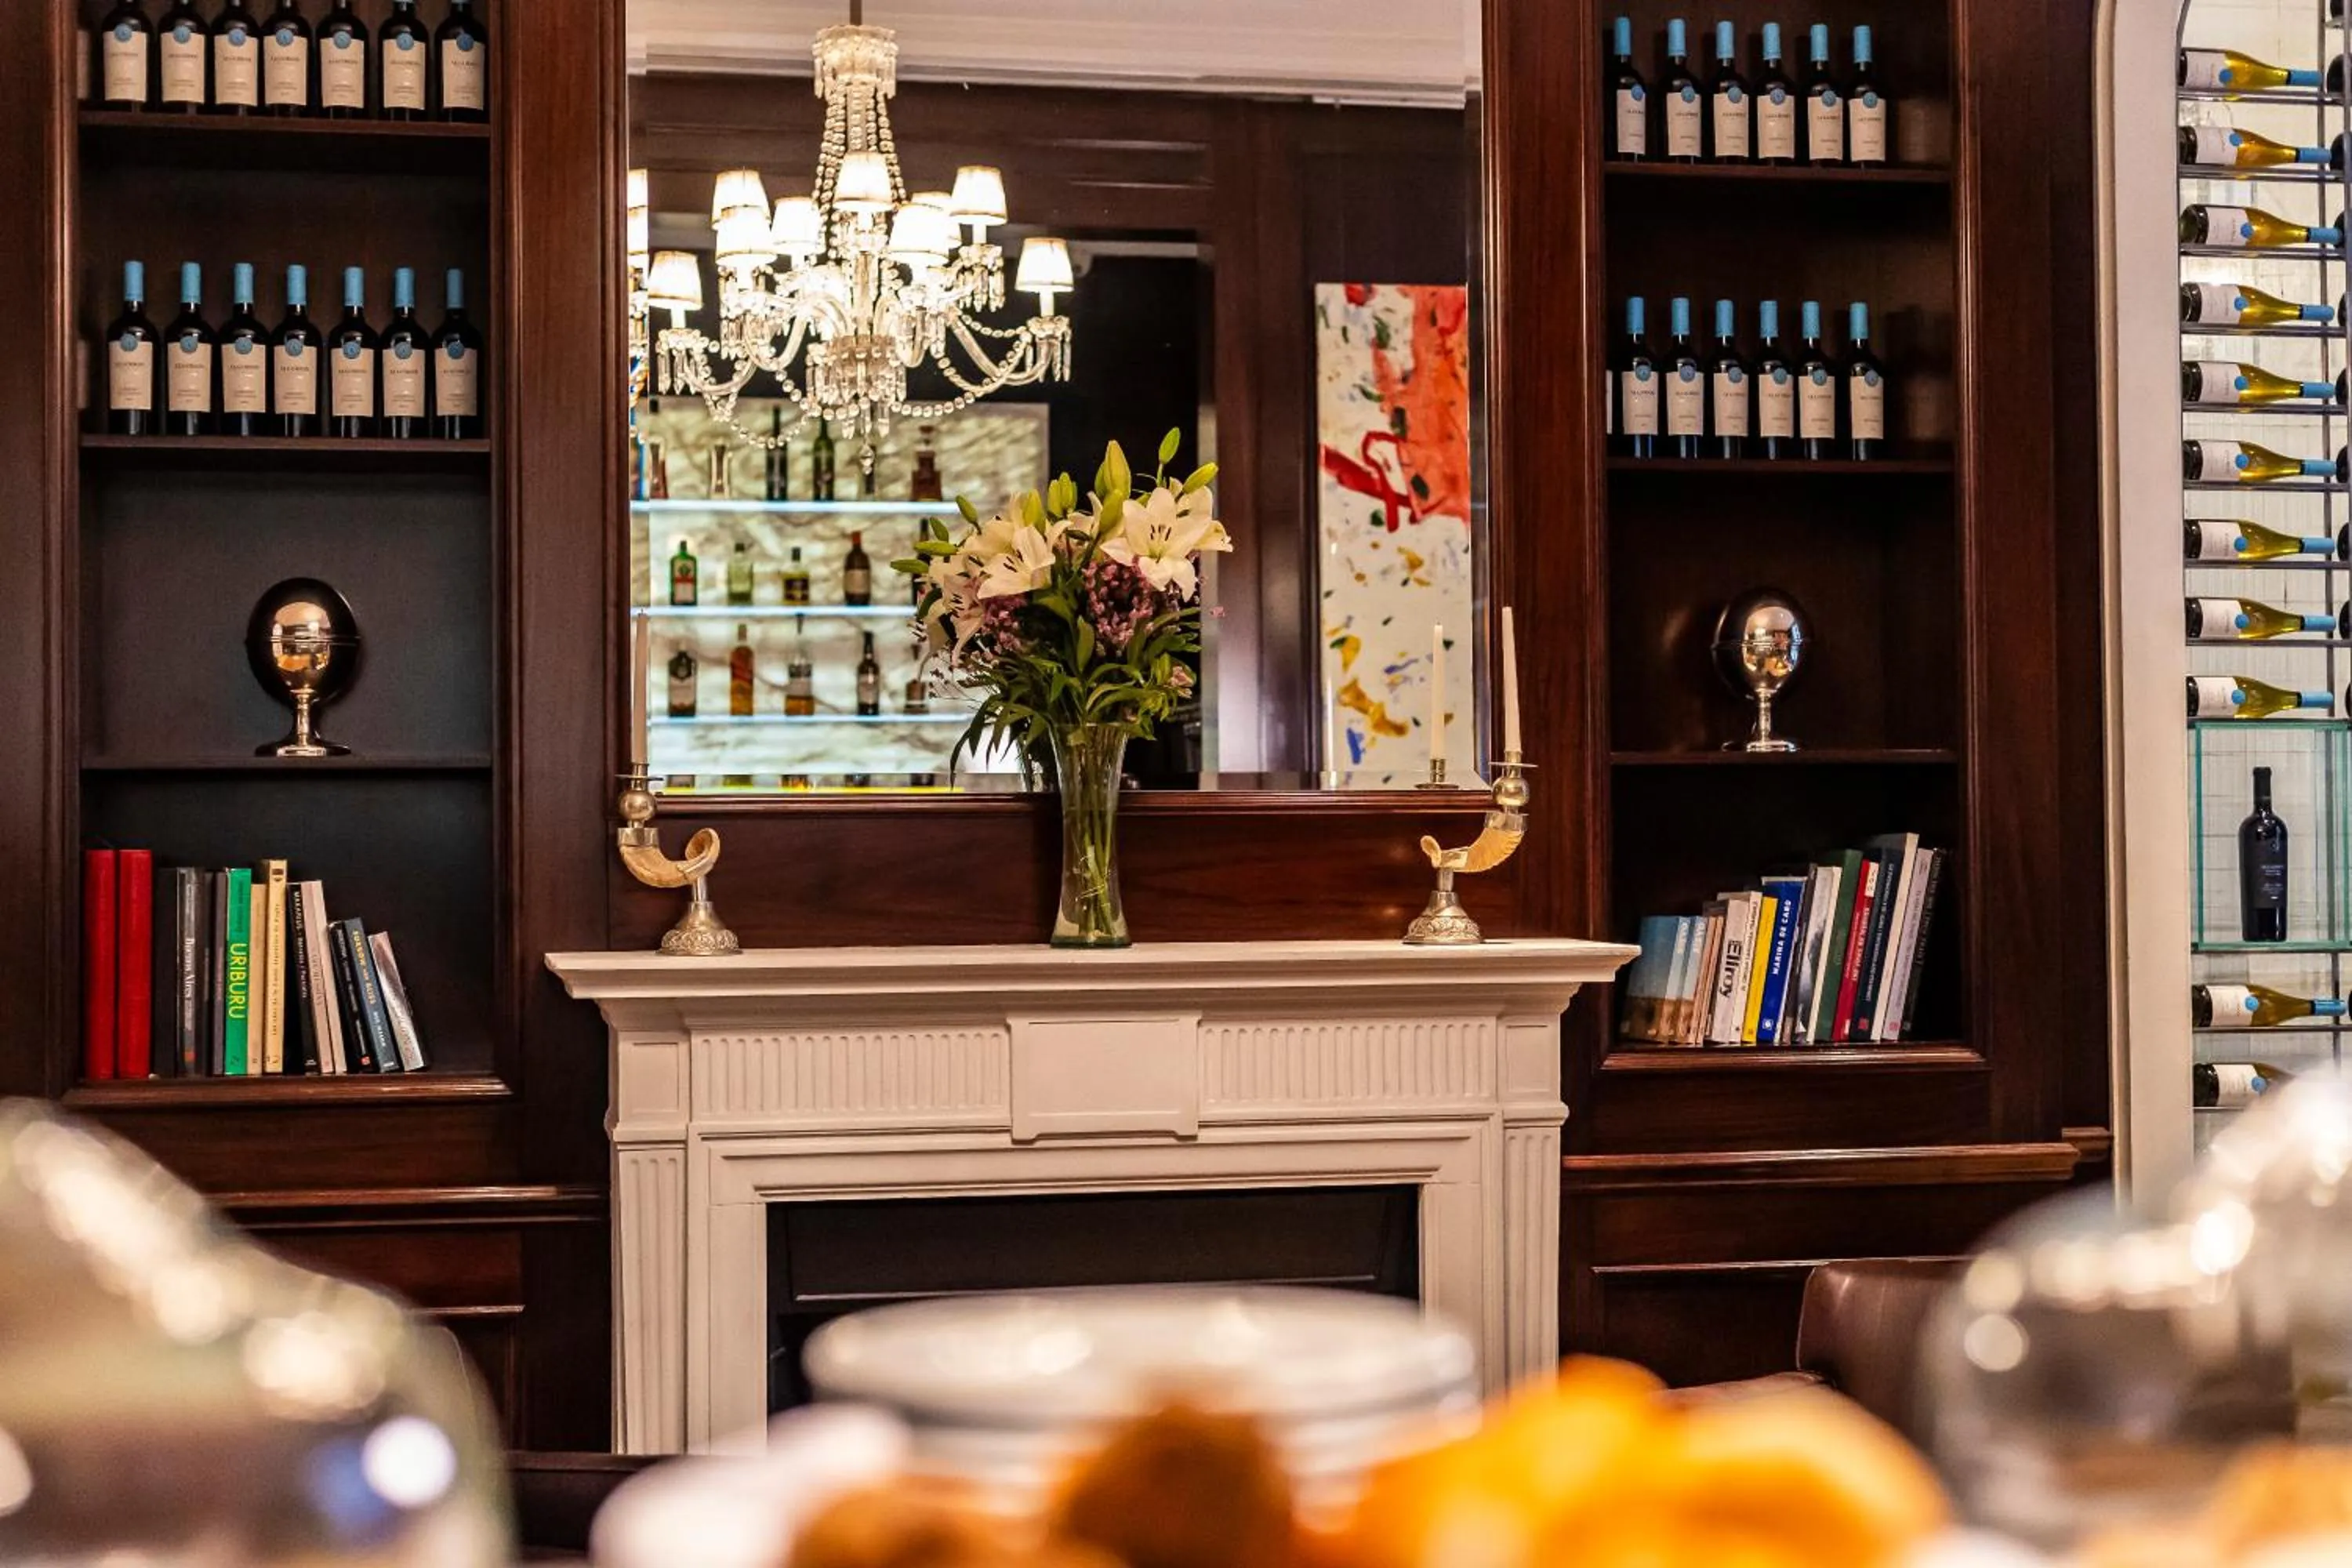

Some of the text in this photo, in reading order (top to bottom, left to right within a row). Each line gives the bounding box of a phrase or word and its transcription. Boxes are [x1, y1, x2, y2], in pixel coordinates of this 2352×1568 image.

[184, 938, 194, 971] Buenos
[1719, 939, 1742, 998] Ellroy
[1773, 940, 1784, 975] MARINA
[184, 974, 195, 1000] Aires
[228, 942, 248, 1019] URIBURU
